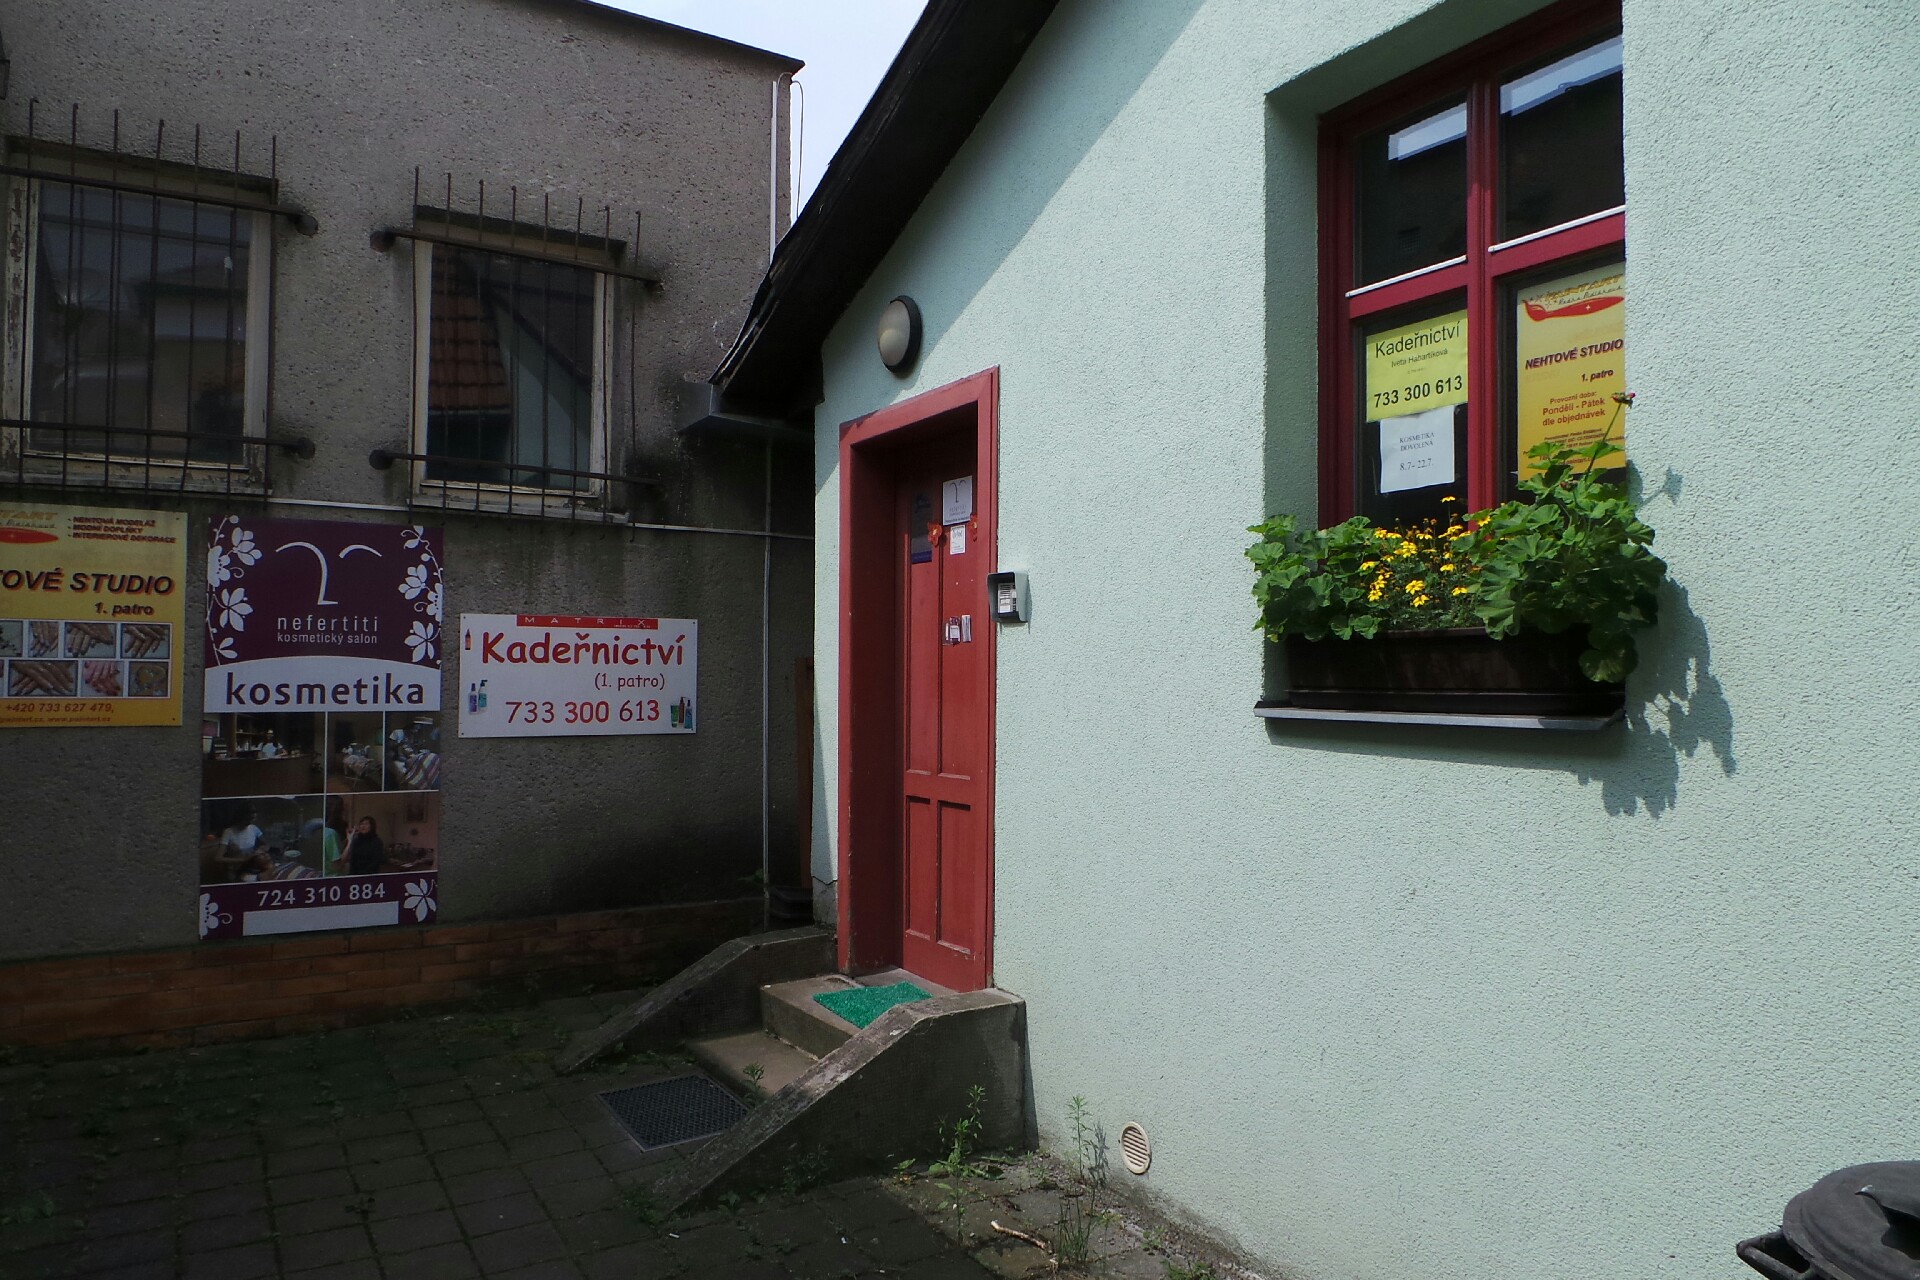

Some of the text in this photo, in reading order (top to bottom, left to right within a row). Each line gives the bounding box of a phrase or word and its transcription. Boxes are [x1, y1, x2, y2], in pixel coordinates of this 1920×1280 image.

[1375, 320, 1460, 358] Kadeřnictví
[1525, 338, 1624, 370] NEHTOVÉ STUDIO
[1581, 369, 1614, 382] 1. patro
[1373, 375, 1463, 408] 733 300 613
[1549, 394, 1578, 404] Provozní
[1542, 404, 1574, 415] Pondělí
[1581, 398, 1606, 409] Pátek
[1542, 408, 1606, 426] dle objednávek
[70, 571, 176, 596] STUDIO
[94, 601, 155, 617] 1. patro
[277, 614, 378, 632] nefertiti
[524, 616, 645, 626] MATRIX
[277, 632, 377, 645] kosmetický salon
[482, 631, 687, 665] Kadeřnictví
[226, 672, 424, 705] kosmetika
[594, 672, 665, 691] (1. patro)
[5, 702, 114, 714] +420 733 627 479,
[505, 699, 660, 724] 733 300 613
[257, 882, 386, 907] 724 310 884
